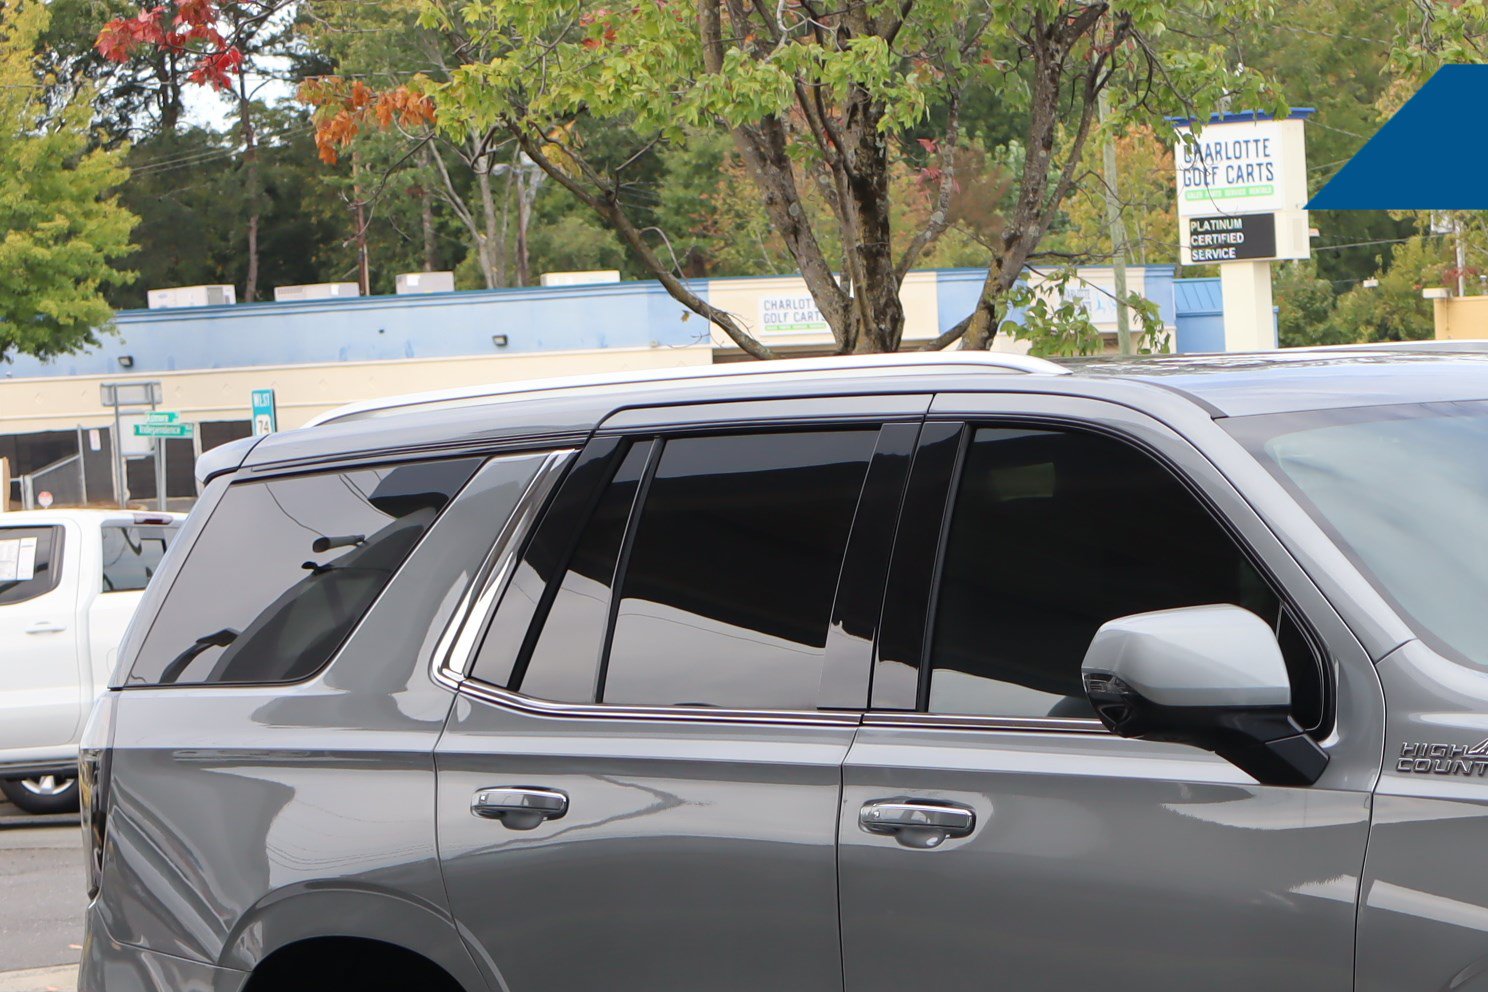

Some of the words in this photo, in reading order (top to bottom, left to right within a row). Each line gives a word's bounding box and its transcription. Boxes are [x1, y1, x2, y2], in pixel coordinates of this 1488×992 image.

[1183, 166, 1219, 187] GOLF
[1226, 162, 1274, 184] CARTS
[1190, 218, 1243, 232] PLATINUM
[1190, 232, 1245, 246] CERTIFIED
[1191, 247, 1237, 261] SERVICE
[763, 312, 790, 324] GOLF
[258, 420, 270, 433] 74
[1401, 742, 1470, 758] HIGH
